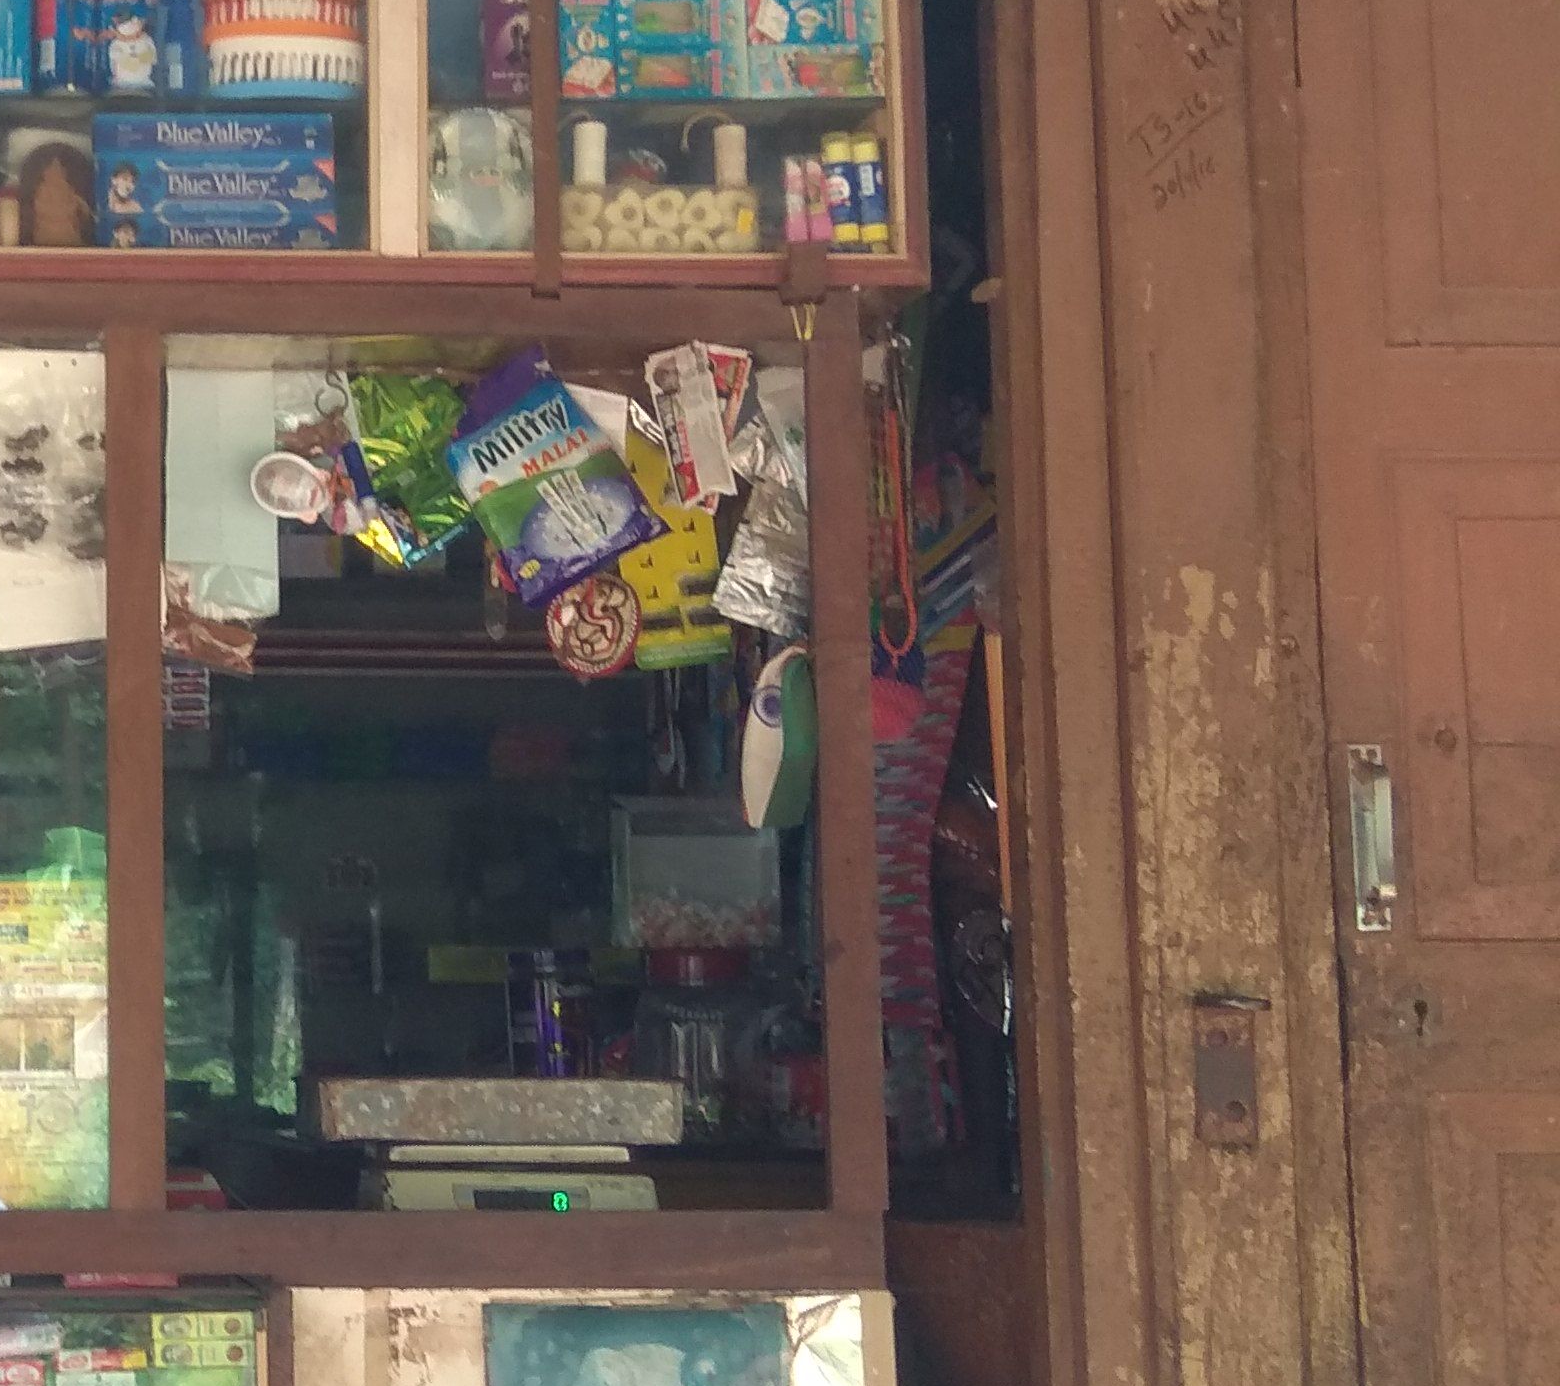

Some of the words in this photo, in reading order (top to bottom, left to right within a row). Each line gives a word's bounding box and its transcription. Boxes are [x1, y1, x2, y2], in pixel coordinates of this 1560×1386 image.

[157, 122, 202, 145] Blue
[204, 122, 266, 149] Valley
[168, 172, 210, 196] Blue
[209, 173, 271, 201] Valley
